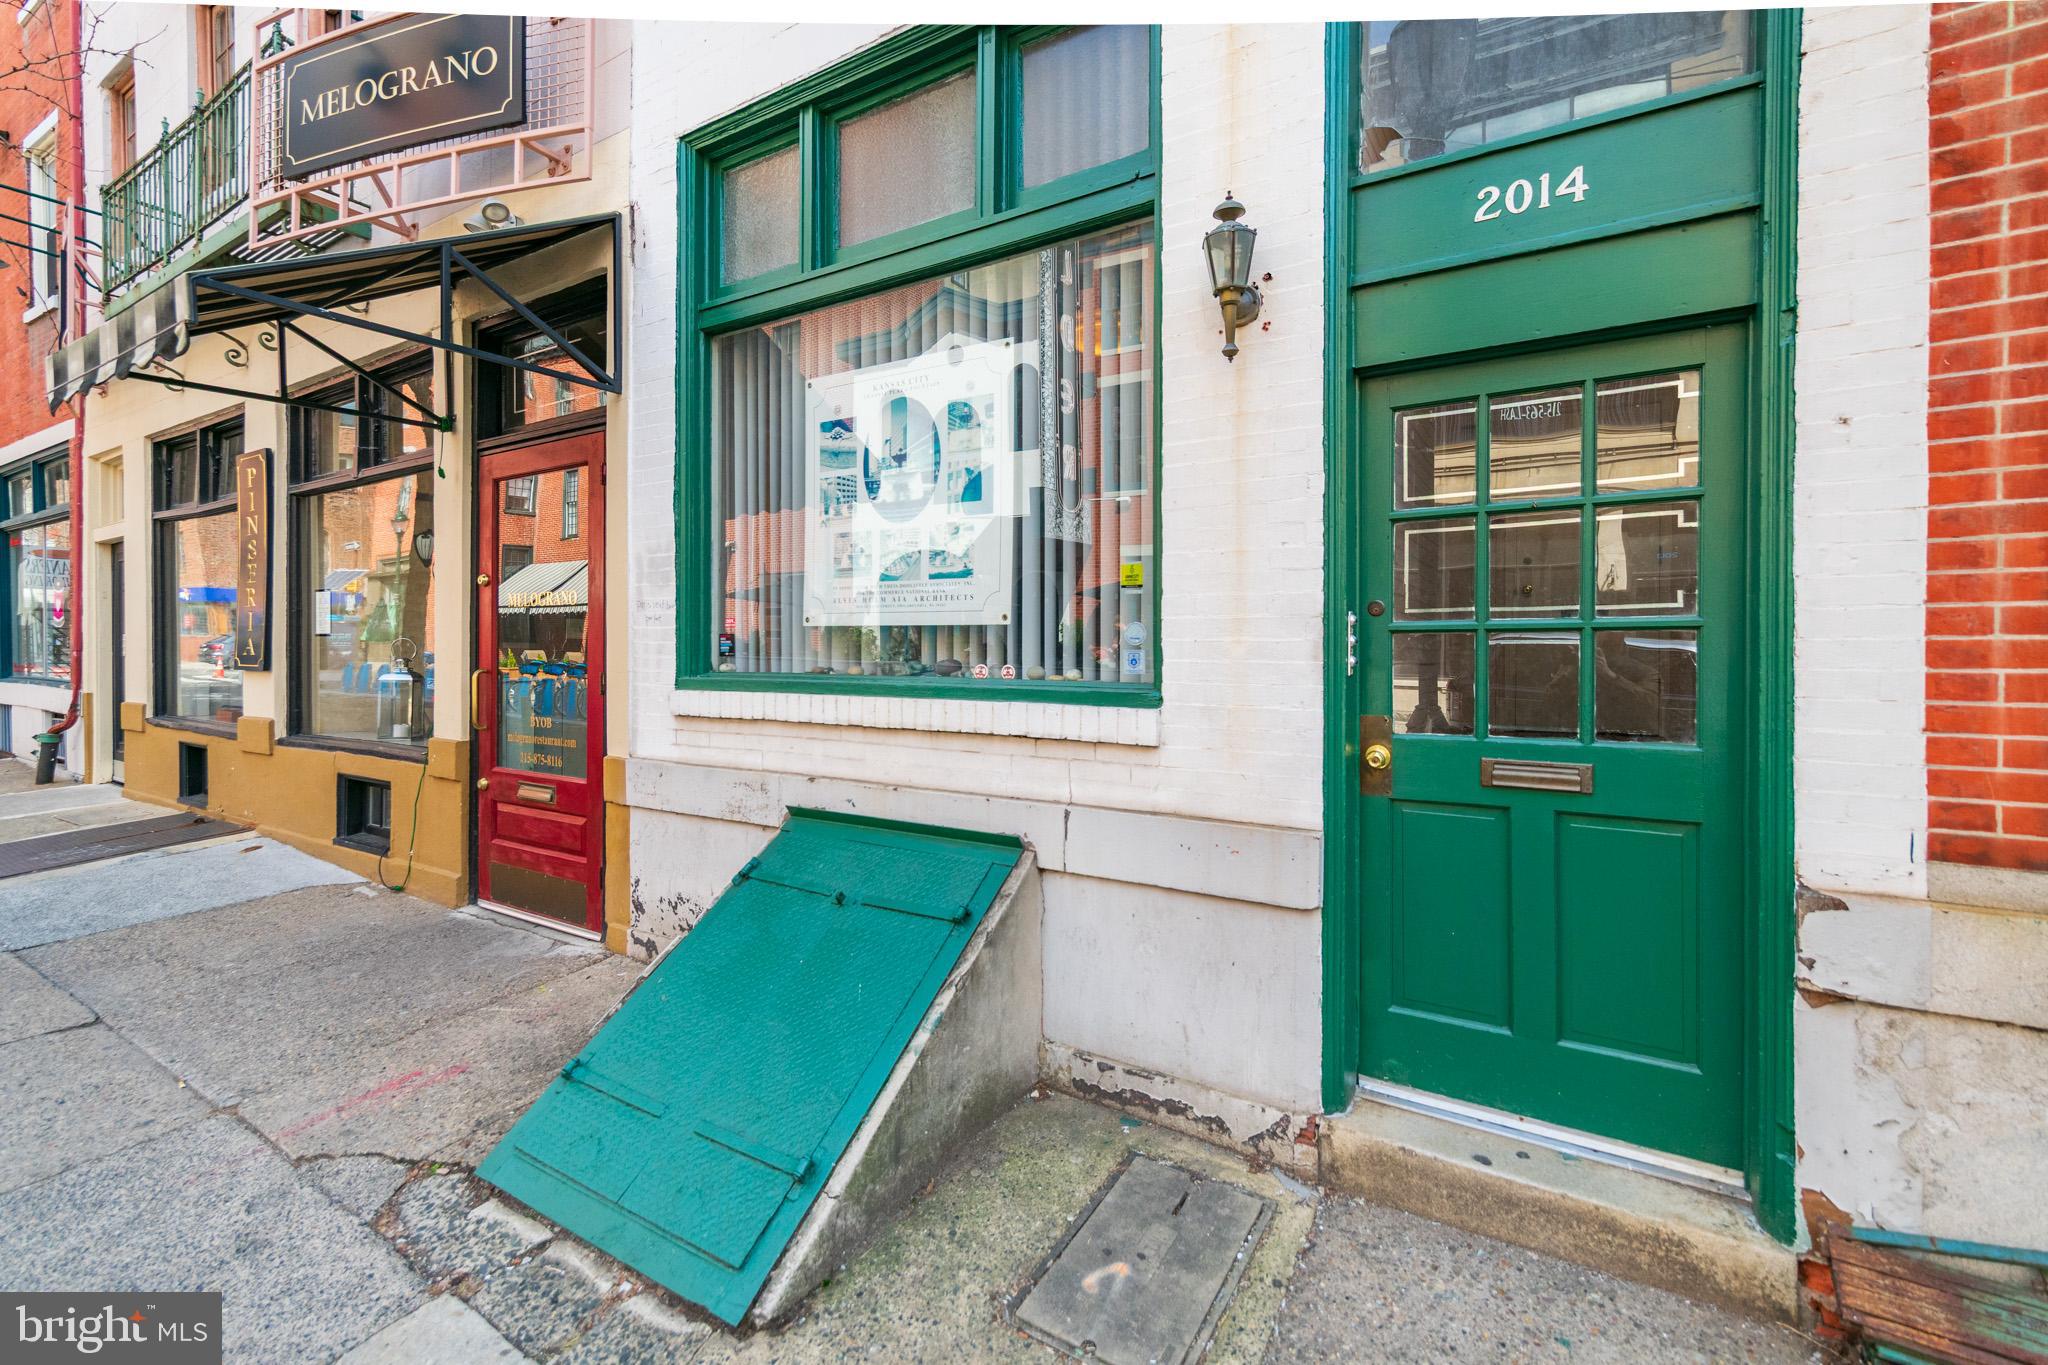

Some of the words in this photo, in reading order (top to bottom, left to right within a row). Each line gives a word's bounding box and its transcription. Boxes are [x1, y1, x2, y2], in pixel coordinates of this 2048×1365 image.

[299, 46, 498, 125] MELOGRANO
[1474, 165, 1590, 223] 2014
[243, 467, 258, 656] PINSERIA
[507, 589, 578, 608] MELOGRANO
[915, 594, 975, 603] ARCHITECTS
[530, 715, 552, 728] BYOB
